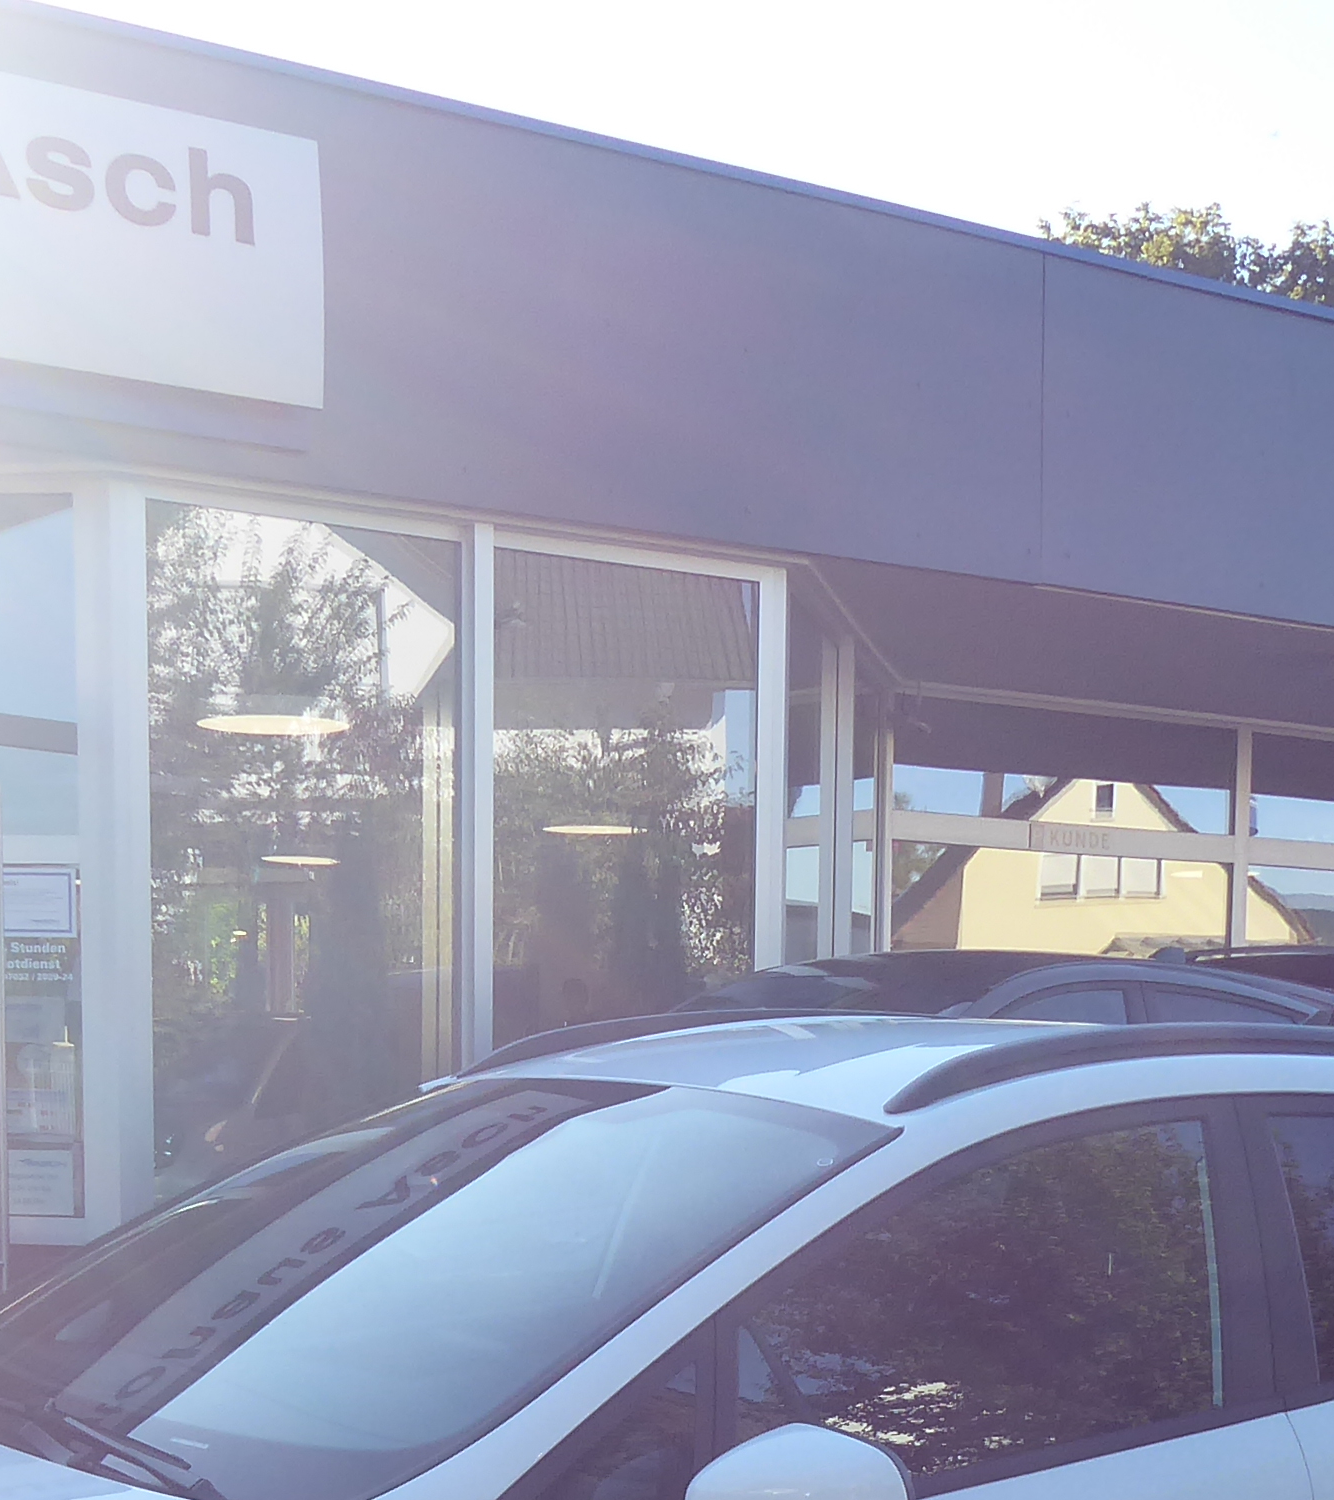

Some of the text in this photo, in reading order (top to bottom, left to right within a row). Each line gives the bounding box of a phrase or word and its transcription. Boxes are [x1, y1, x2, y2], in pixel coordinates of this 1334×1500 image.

[1049, 828, 1111, 850] KUNDE
[10, 941, 66, 953] Stunden
[6, 957, 61, 969] otdienst
